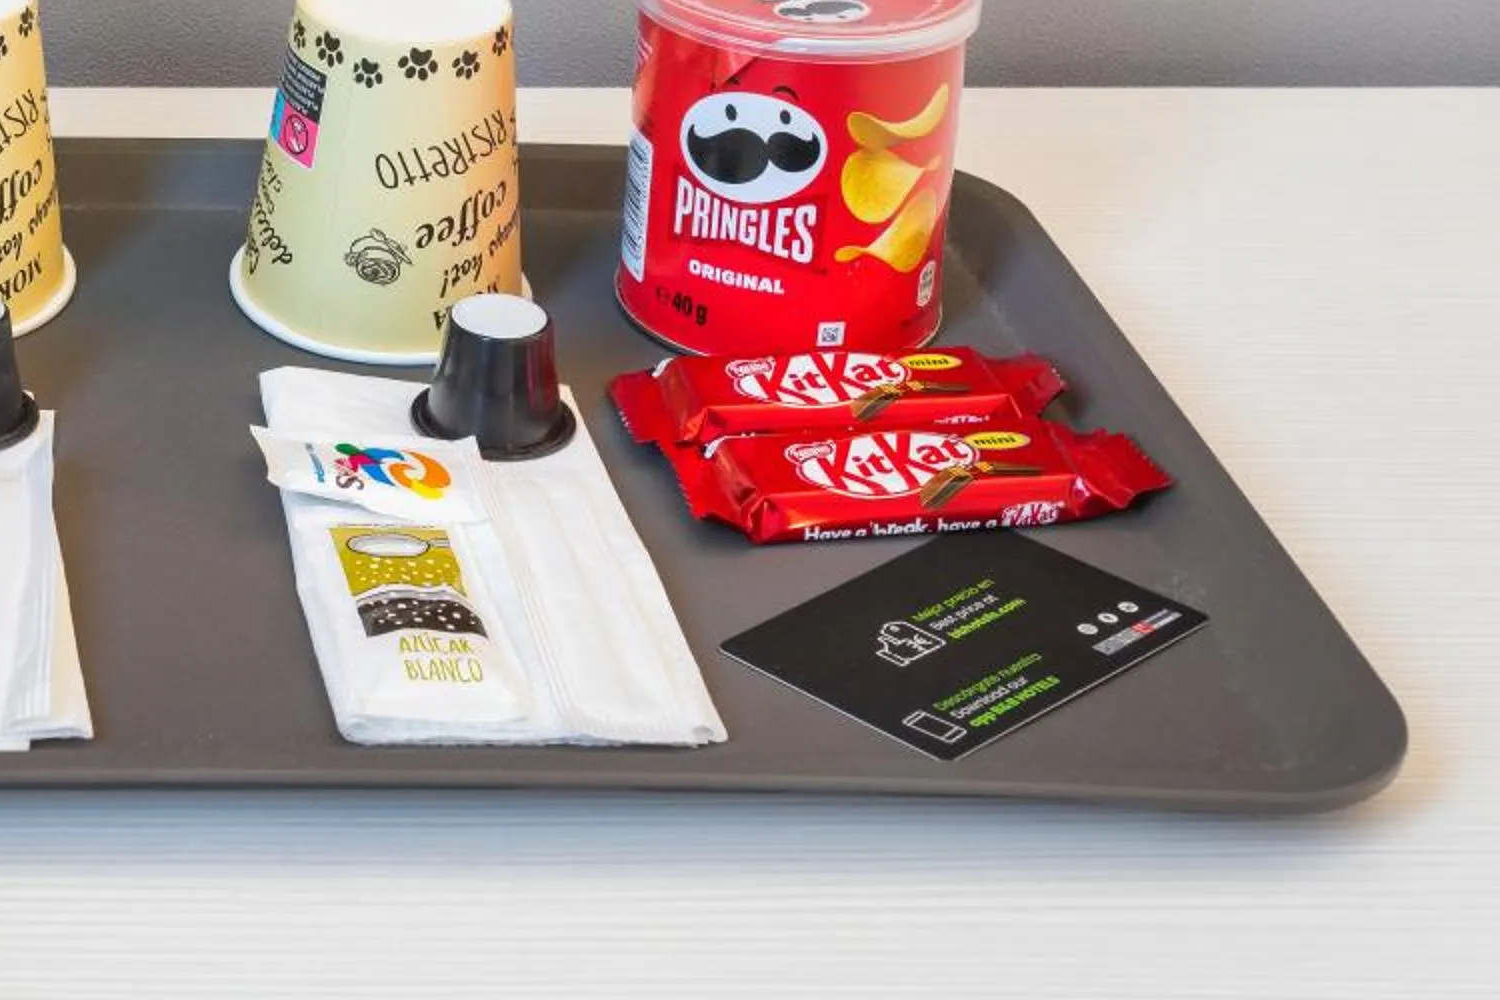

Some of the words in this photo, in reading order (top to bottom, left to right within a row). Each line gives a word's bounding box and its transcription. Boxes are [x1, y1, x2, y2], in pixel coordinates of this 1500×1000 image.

[415, 180, 507, 249] coffee
[673, 175, 818, 264] PRINGLES
[688, 258, 785, 295] ORIGINAL
[671, 291, 693, 317] 40
[696, 303, 708, 326] g
[974, 436, 1016, 446] mini
[955, 600, 986, 620] price
[404, 658, 483, 683] BLANCO
